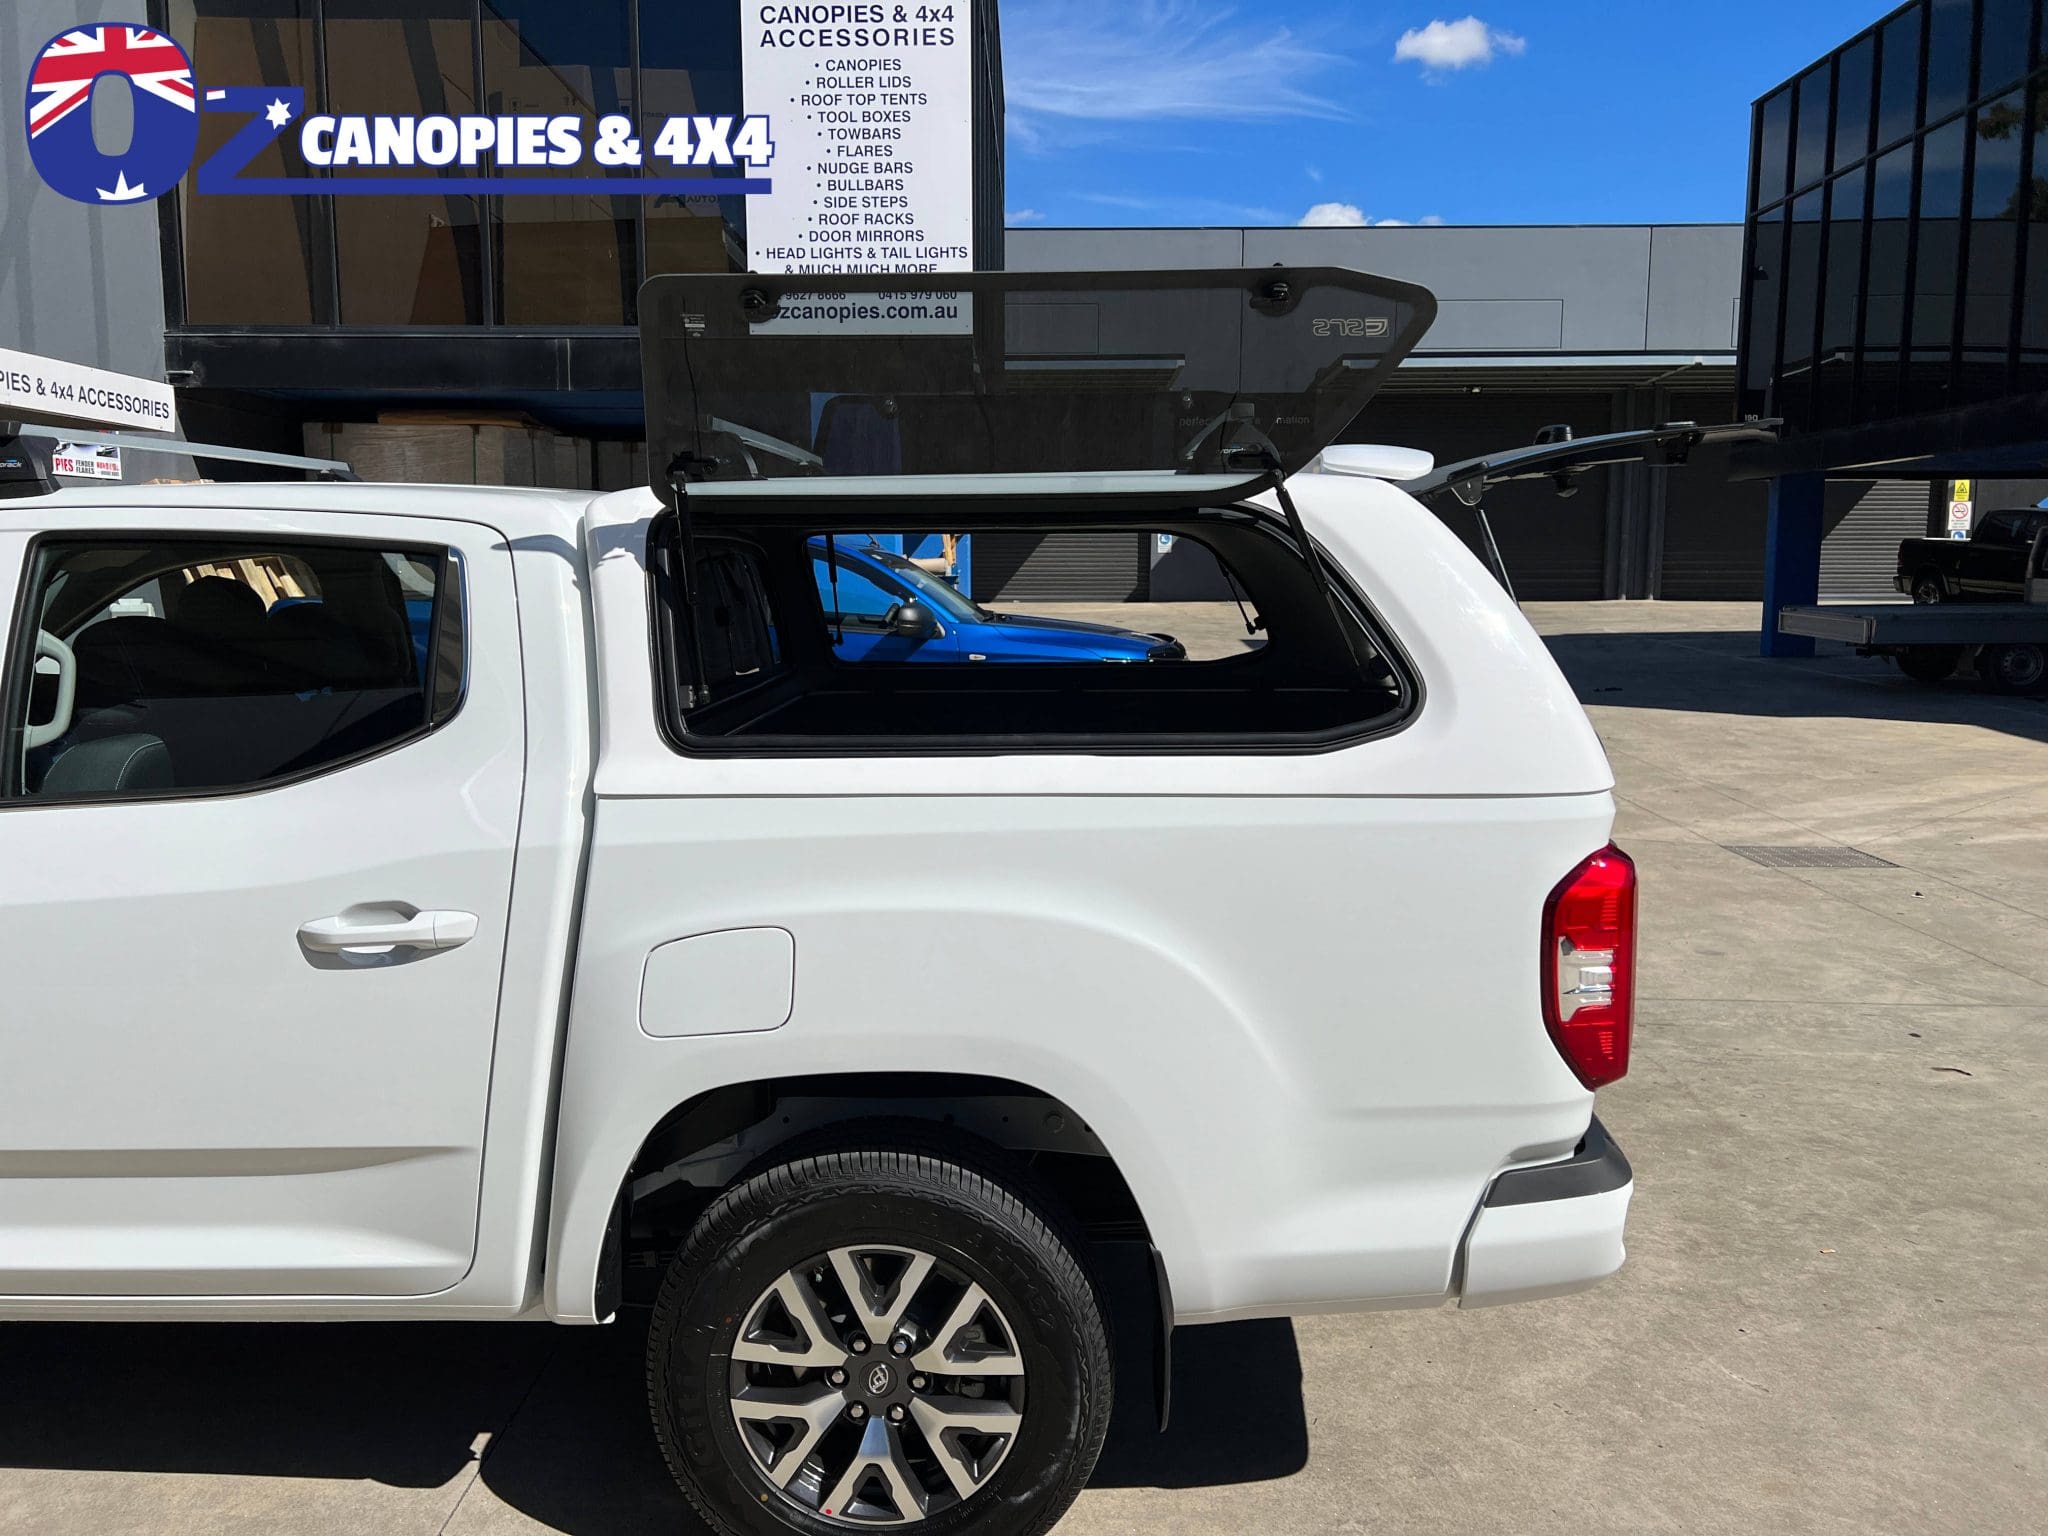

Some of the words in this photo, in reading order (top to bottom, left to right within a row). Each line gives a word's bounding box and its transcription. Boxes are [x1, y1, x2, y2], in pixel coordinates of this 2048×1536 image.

[759, 5, 885, 24] CANOPIES
[892, 5, 908, 22] &
[915, 5, 955, 22] 4x4
[759, 28, 955, 47] ACCESSORIES
[825, 59, 902, 71] CANOPIES
[816, 77, 874, 89] ROLLER
[879, 76, 912, 88] LIDS
[801, 94, 843, 106] ROOF
[846, 94, 876, 106] TOP
[880, 93, 928, 105] TENTS
[817, 111, 858, 123] TOOL
[862, 111, 911, 123] BOXES
[827, 128, 902, 140] TOWBARS
[837, 145, 893, 157] FLARES
[817, 163, 869, 174] NUDGE
[874, 162, 914, 174] BARS
[827, 179, 904, 191] BULLBARS
[823, 197, 858, 208] SIDE
[862, 196, 908, 208] STEPS
[818, 214, 860, 225] ROOF
[864, 213, 914, 225] RACKS
[809, 231, 852, 242] DOOR
[856, 230, 924, 242] MIRRORS
[766, 248, 806, 259] HEAD
[810, 247, 862, 259] LIGHTS
[867, 247, 877, 259] &
[880, 247, 912, 259] TAIL
[916, 247, 968, 259] LIGHTS
[798, 264, 842, 274] MUCH
[846, 264, 890, 274] MUCH
[894, 264, 937, 274] MORE
[36, 377, 47, 396] &
[50, 382, 75, 401] 4x4
[78, 386, 170, 419] ACCESSORIES
